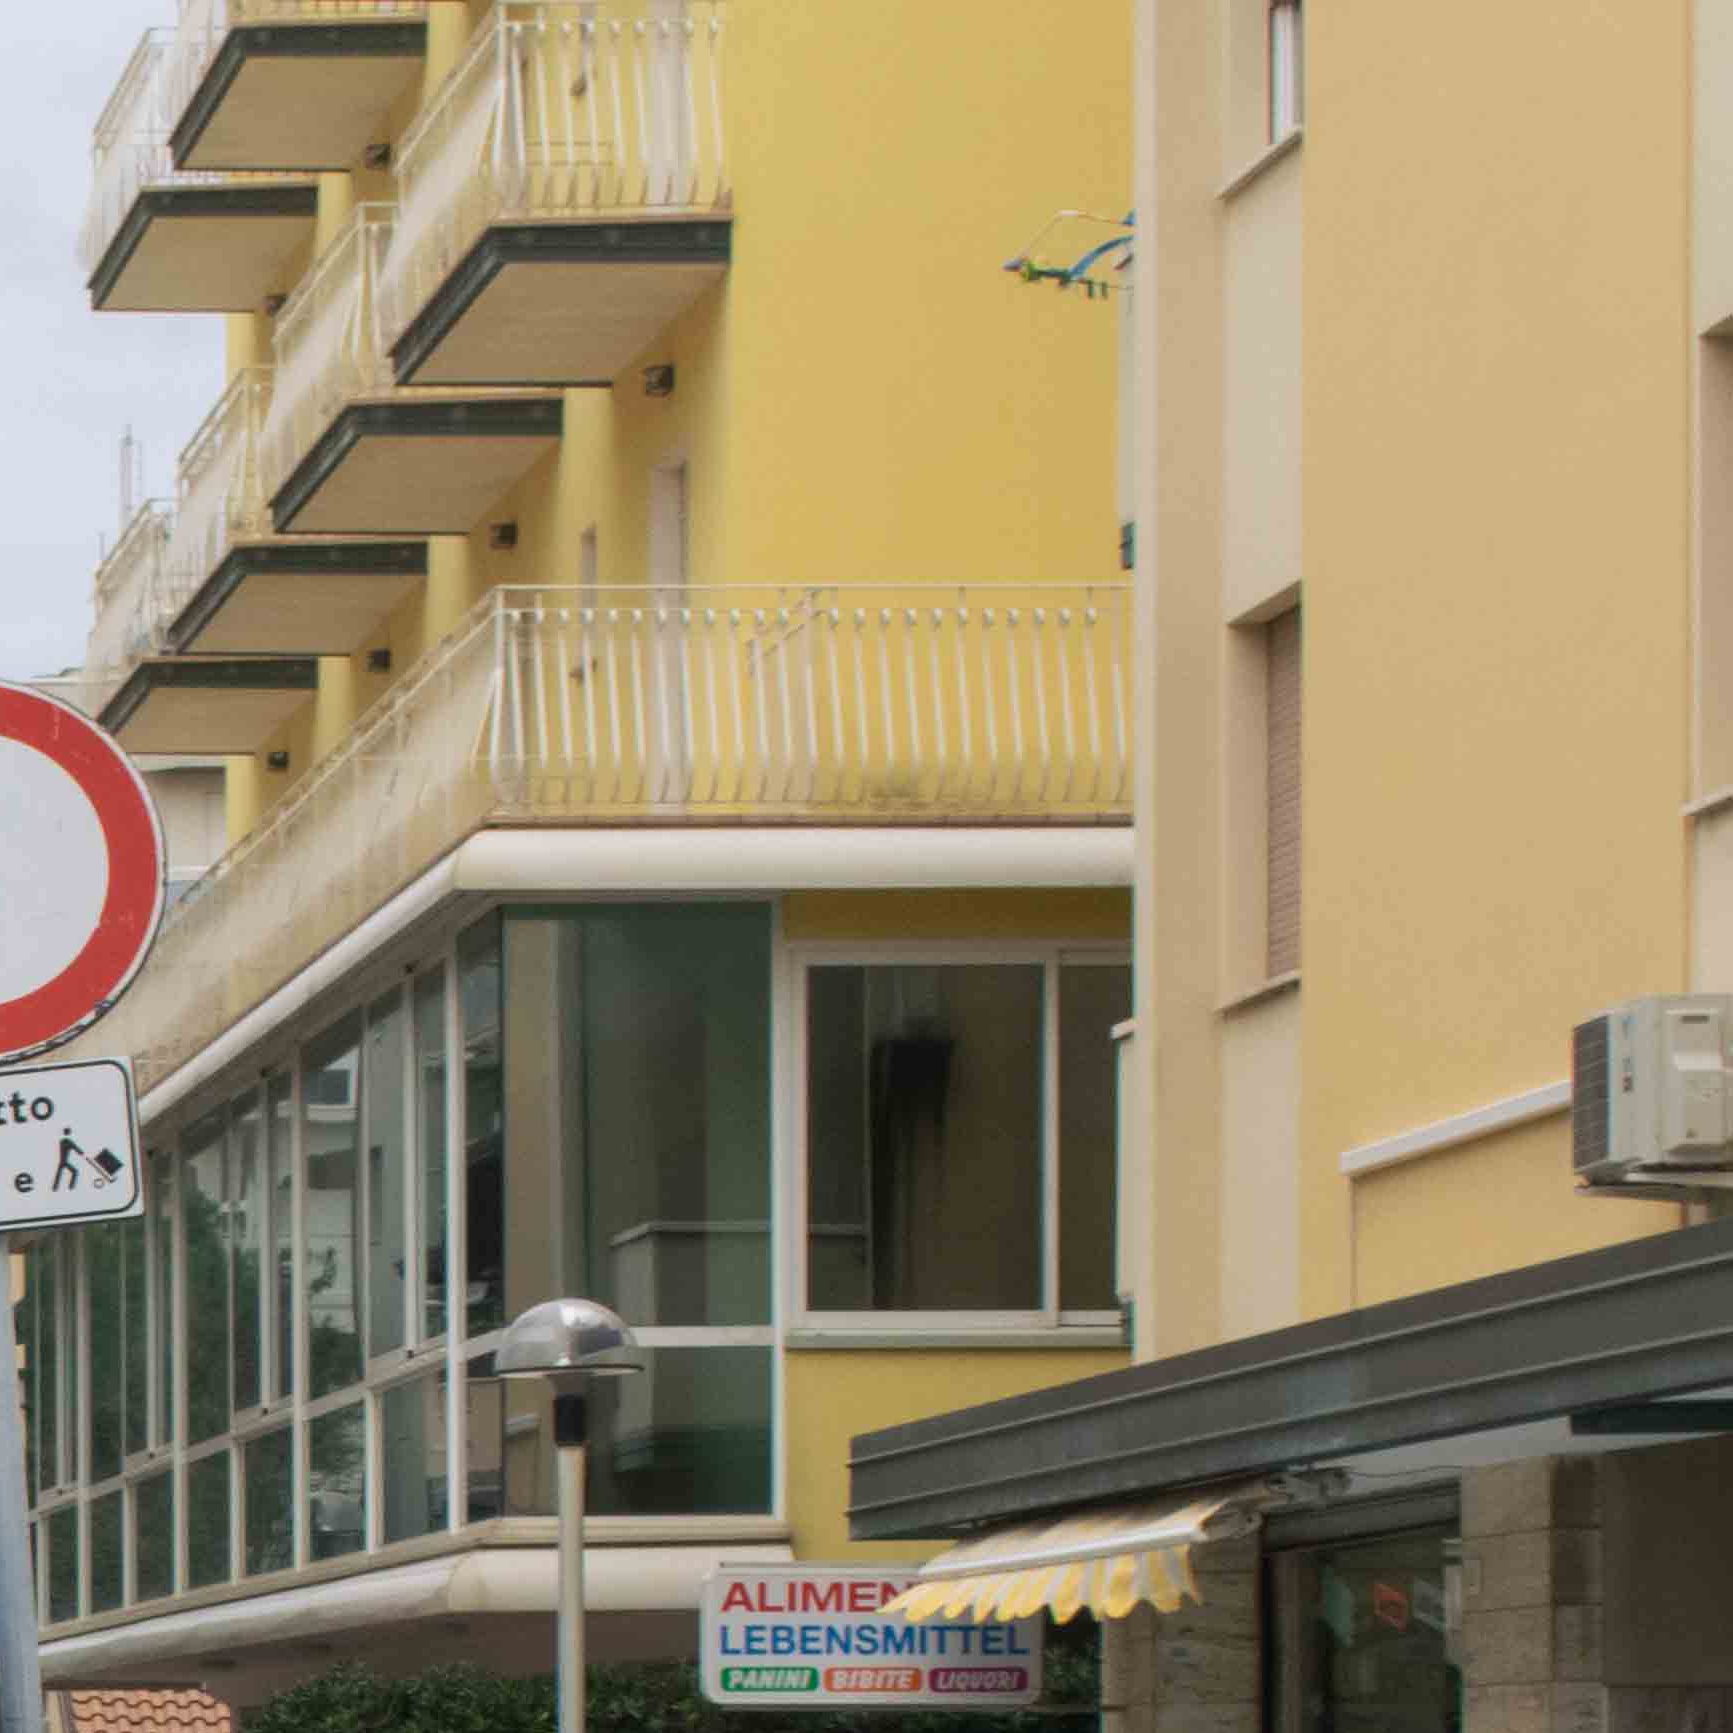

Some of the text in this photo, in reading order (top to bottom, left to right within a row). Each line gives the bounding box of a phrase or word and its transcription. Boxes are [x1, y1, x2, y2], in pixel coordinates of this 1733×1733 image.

[14, 1171, 35, 1194] e
[719, 1624, 1031, 1656] LEBENSMITTEL
[727, 1668, 813, 1689] PANINI
[832, 1668, 913, 1689] BIBITE
[936, 1670, 1020, 1690] LIQUORI
